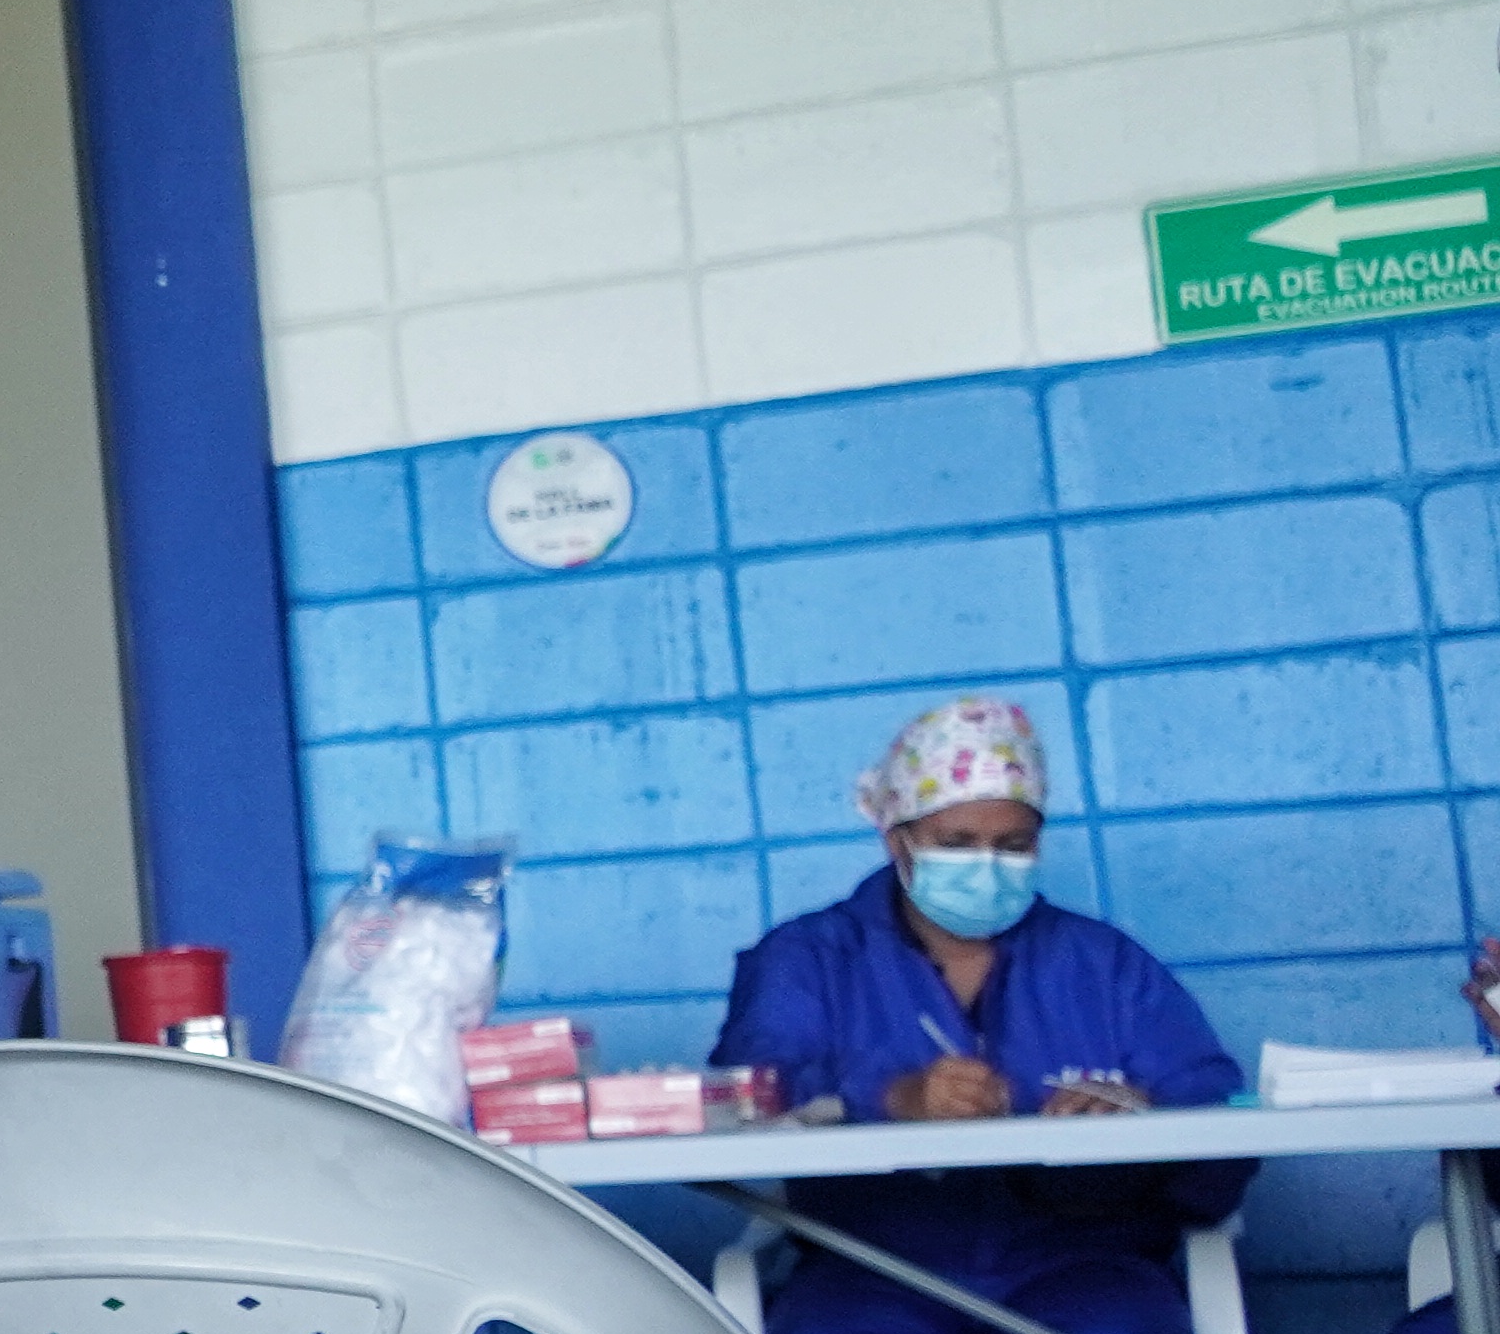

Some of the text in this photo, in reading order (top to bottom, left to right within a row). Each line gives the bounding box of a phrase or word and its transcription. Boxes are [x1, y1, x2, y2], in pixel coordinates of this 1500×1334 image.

[1179, 273, 1273, 311] RUTA
[1279, 265, 1326, 298] DE
[1257, 285, 1417, 321] EVACUATION
